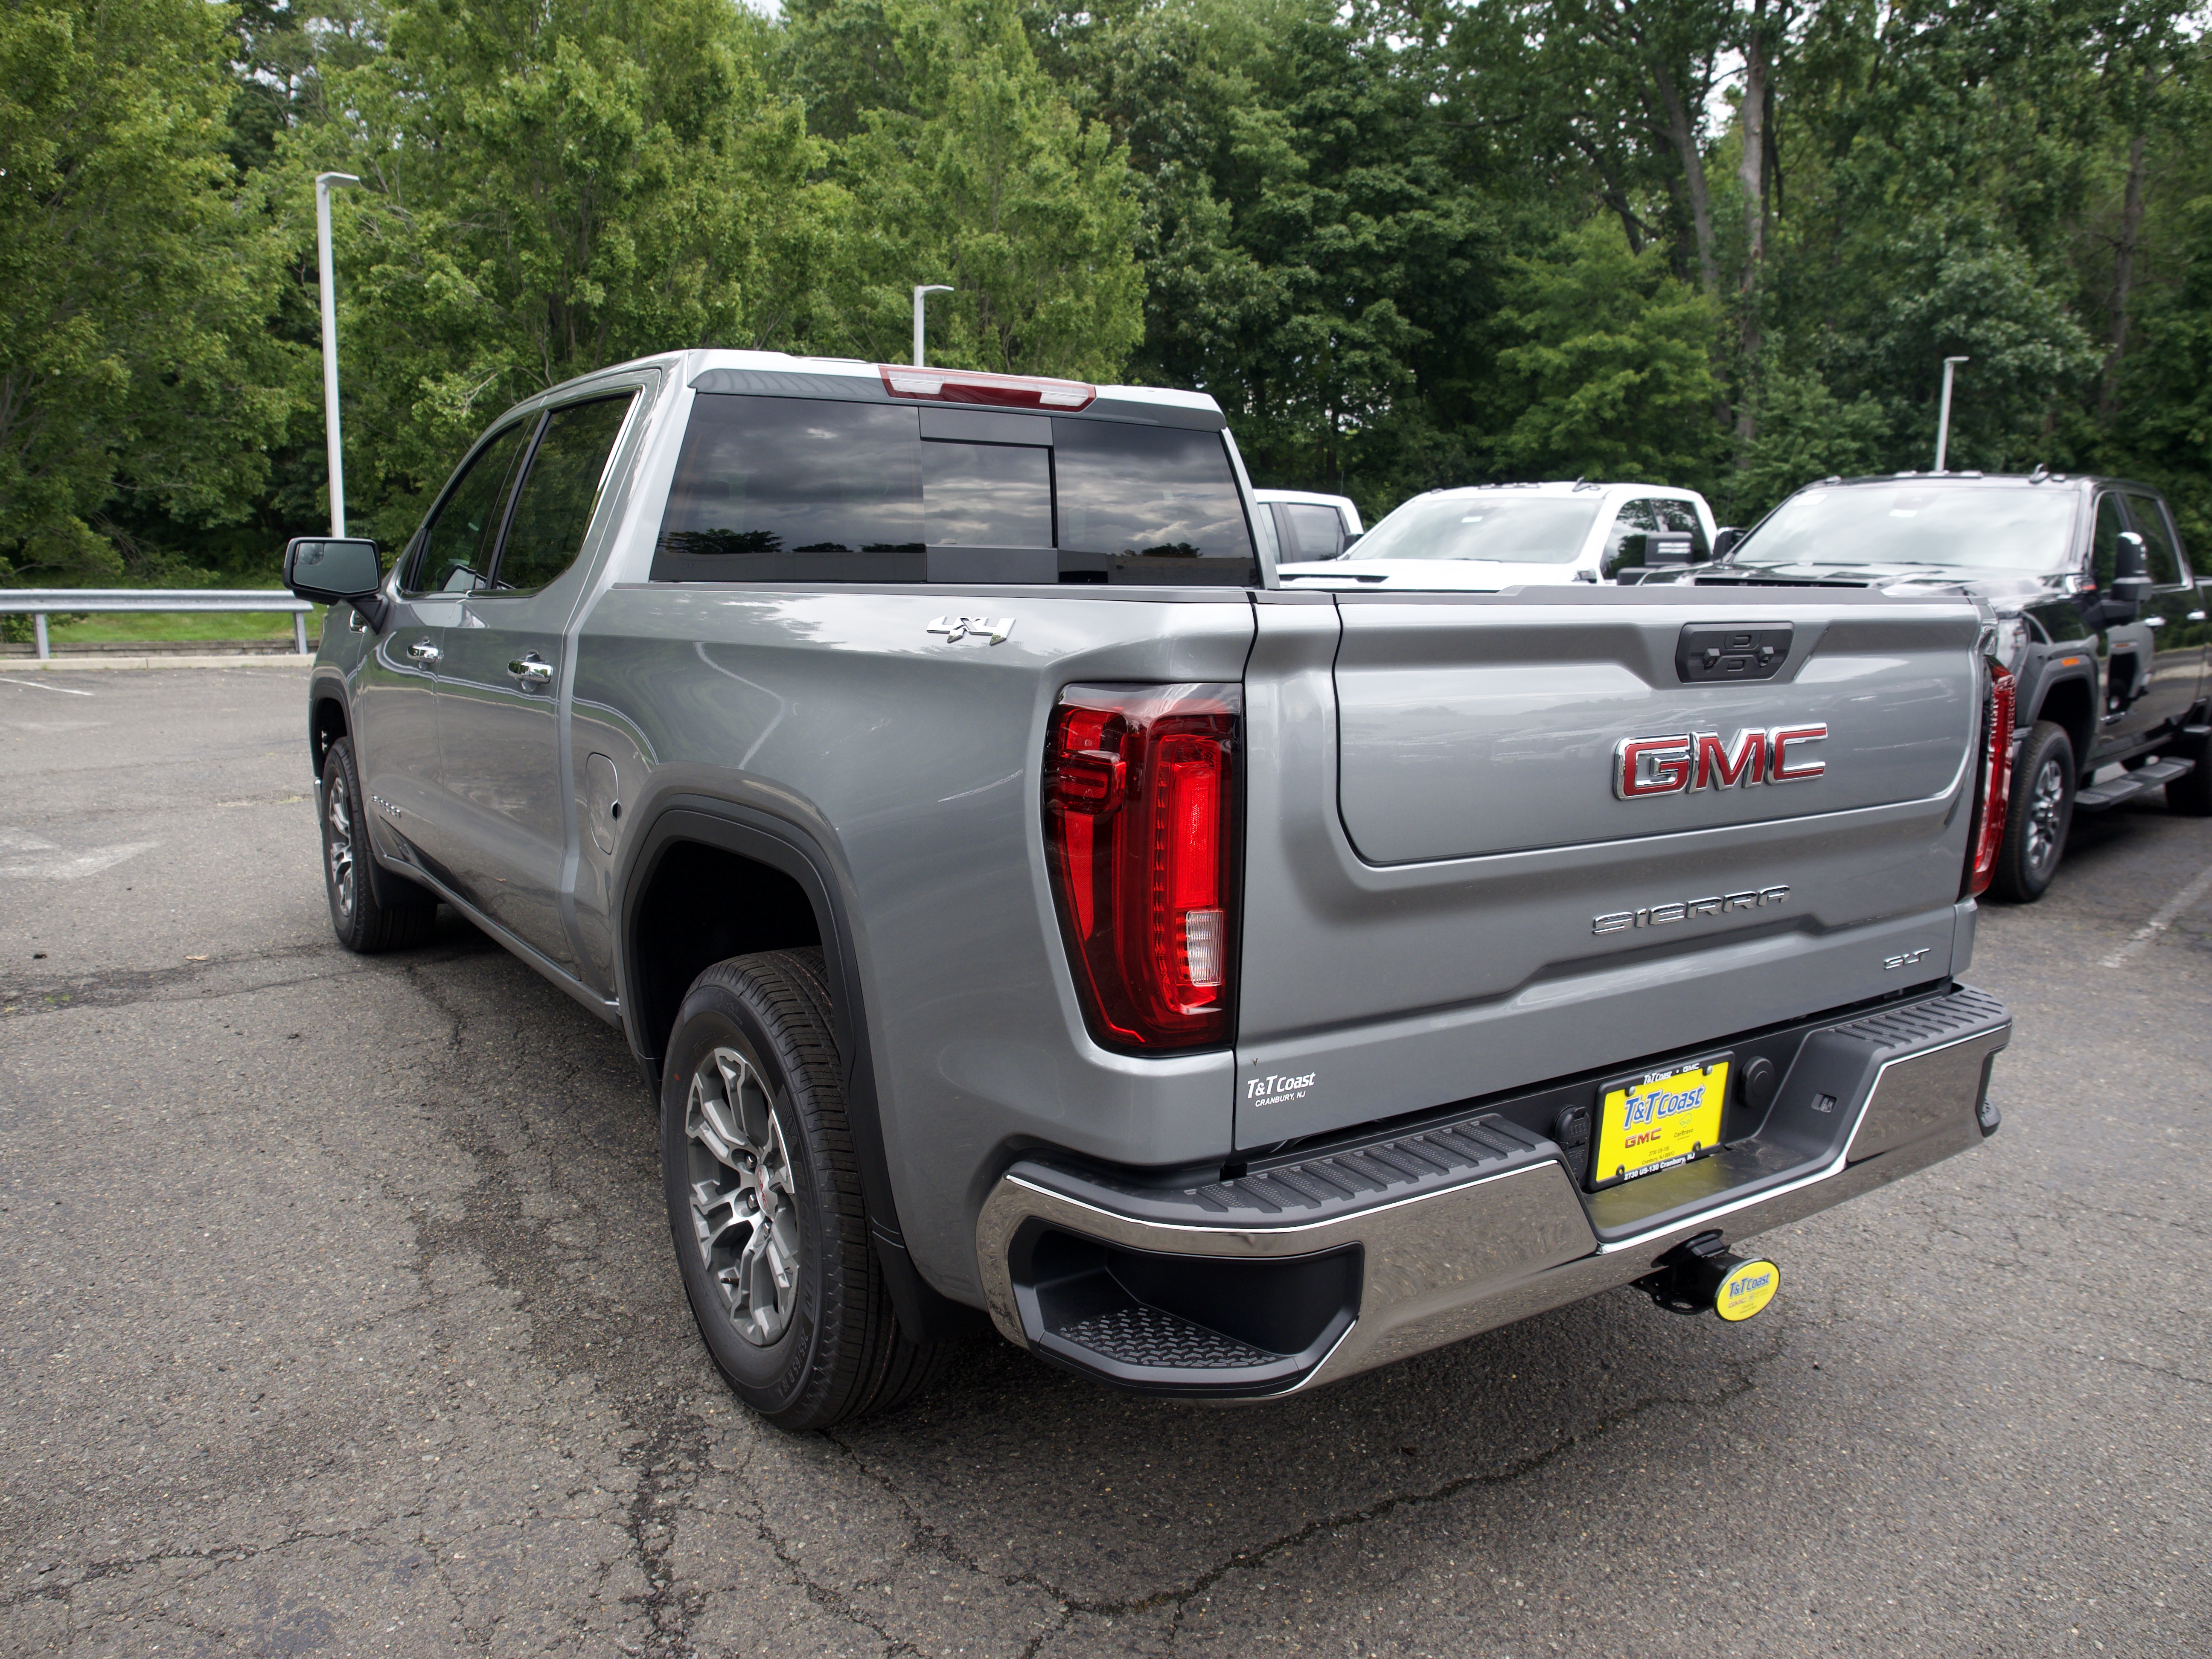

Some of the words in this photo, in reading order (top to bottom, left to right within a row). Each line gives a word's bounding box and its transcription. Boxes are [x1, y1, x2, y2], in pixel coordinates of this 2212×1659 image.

[1612, 722, 1828, 800] GMC
[1592, 885, 1790, 935] SIERRA
[1883, 947, 1931, 970] SLT
[1247, 1074, 1278, 1099] T&T
[1276, 1072, 1316, 1092] Coast
[1643, 1073, 1656, 1085] T&T
[1655, 1071, 1673, 1081] Coast
[1255, 1093, 1295, 1107] CRANBURY,
[1296, 1090, 1306, 1099] NJ
[1623, 1088, 1664, 1130] T&T
[1656, 1083, 1706, 1119] Coast
[1625, 1127, 1662, 1148] GMC
[1624, 1170, 1639, 1181] 2730
[1639, 1164, 1660, 1176] US-130
[1660, 1157, 1686, 1169] Cranbury,
[1687, 1153, 1695, 1161] NJ
[1729, 1277, 1749, 1299] T&T
[1746, 1274, 1770, 1292] Coast
